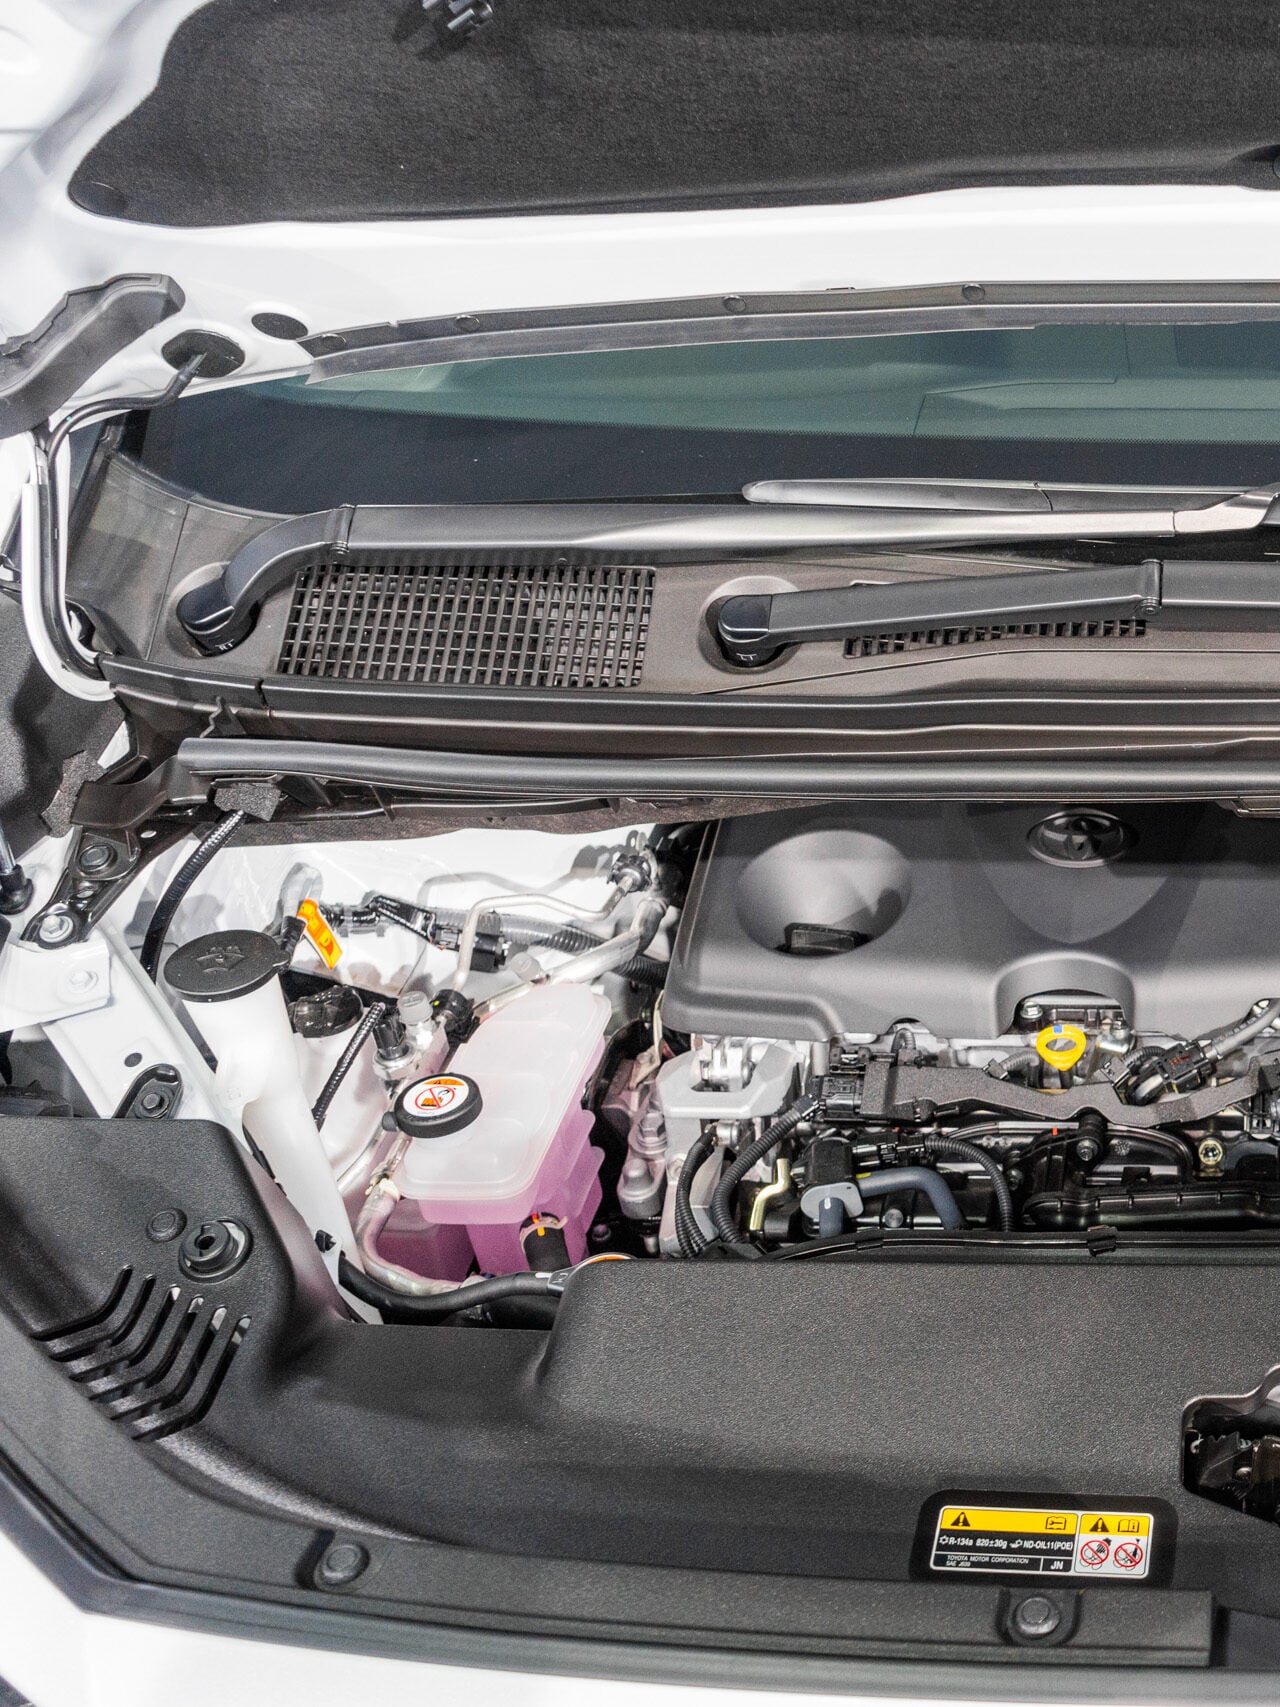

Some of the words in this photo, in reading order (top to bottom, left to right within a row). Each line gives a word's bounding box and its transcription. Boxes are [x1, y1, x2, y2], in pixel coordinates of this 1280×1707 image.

[948, 1536, 974, 1547] R-134a
[990, 1556, 1030, 1564] CORPORATION
[1050, 1560, 1064, 1570] JN
